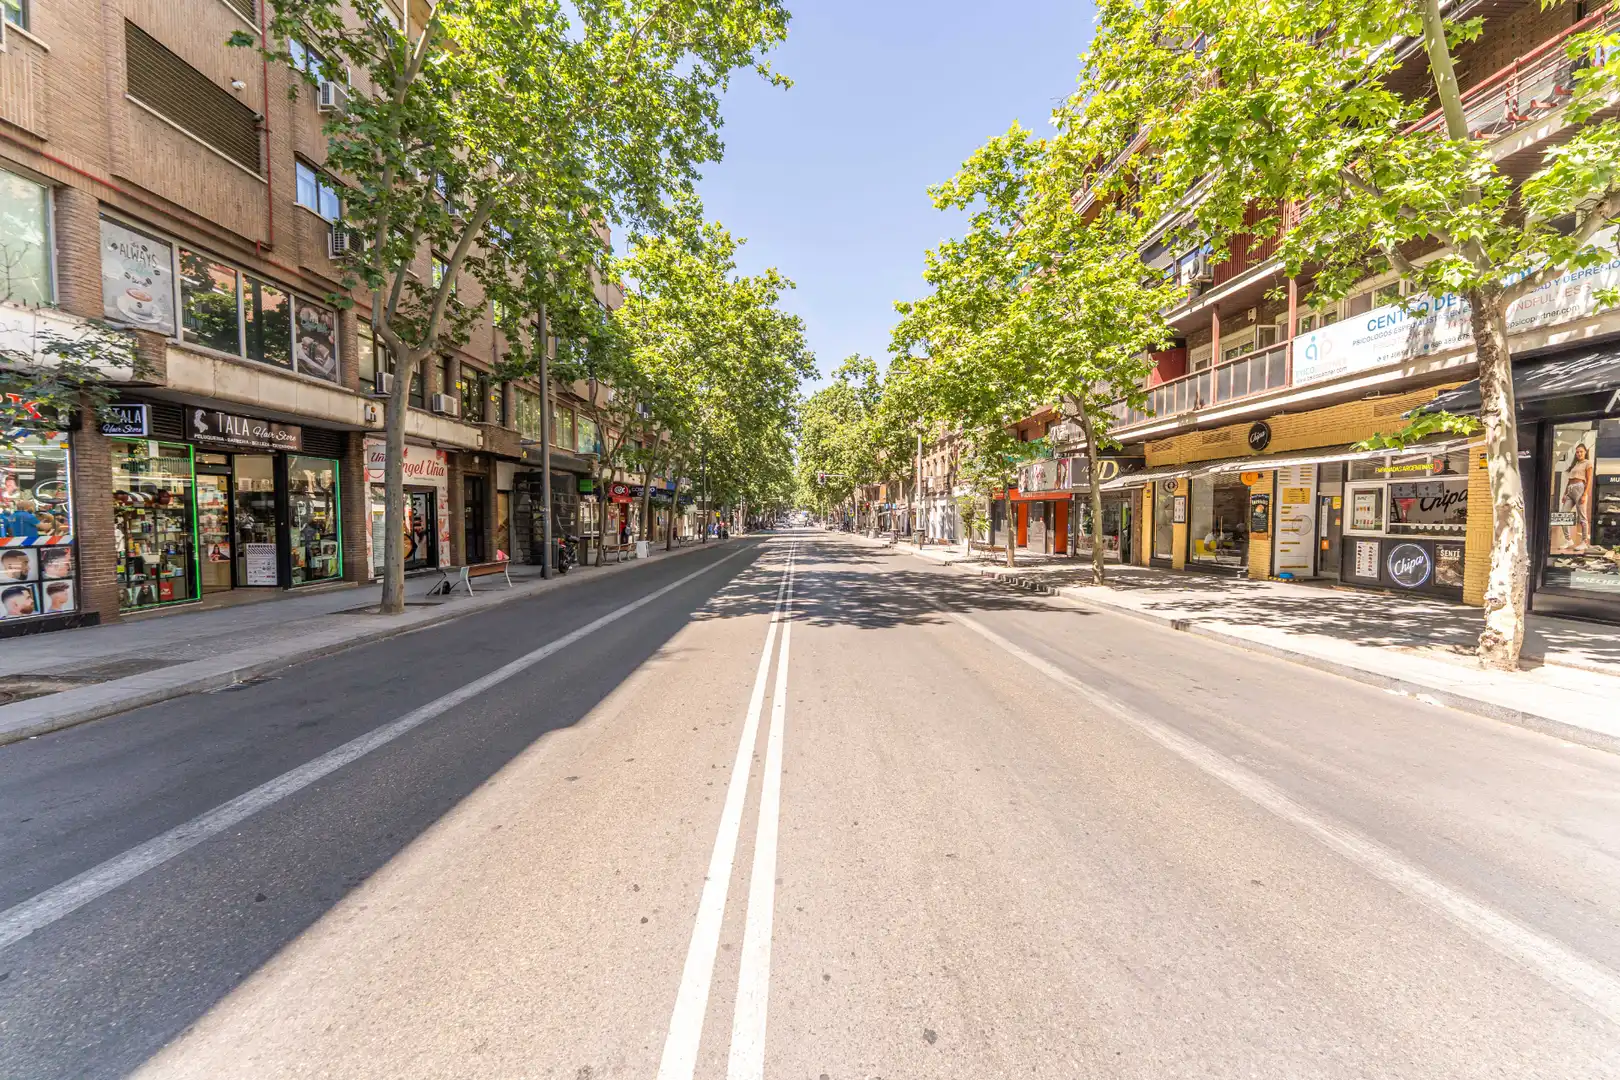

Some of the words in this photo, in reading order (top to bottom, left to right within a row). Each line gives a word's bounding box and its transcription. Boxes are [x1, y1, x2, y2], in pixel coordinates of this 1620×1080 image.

[120, 243, 157, 268] ALWAYS
[1434, 293, 1457, 312] DE
[103, 424, 122, 433] Hair
[122, 424, 143, 433] Store
[216, 412, 250, 437] TALA
[253, 426, 276, 439] Hair
[276, 430, 297, 441] Store
[1249, 430, 1266, 444] Chipa
[371, 452, 386, 462] Uñ
[402, 460, 425, 477] ngel
[426, 460, 445, 477] Uña
[1394, 554, 1425, 576] Chipa
